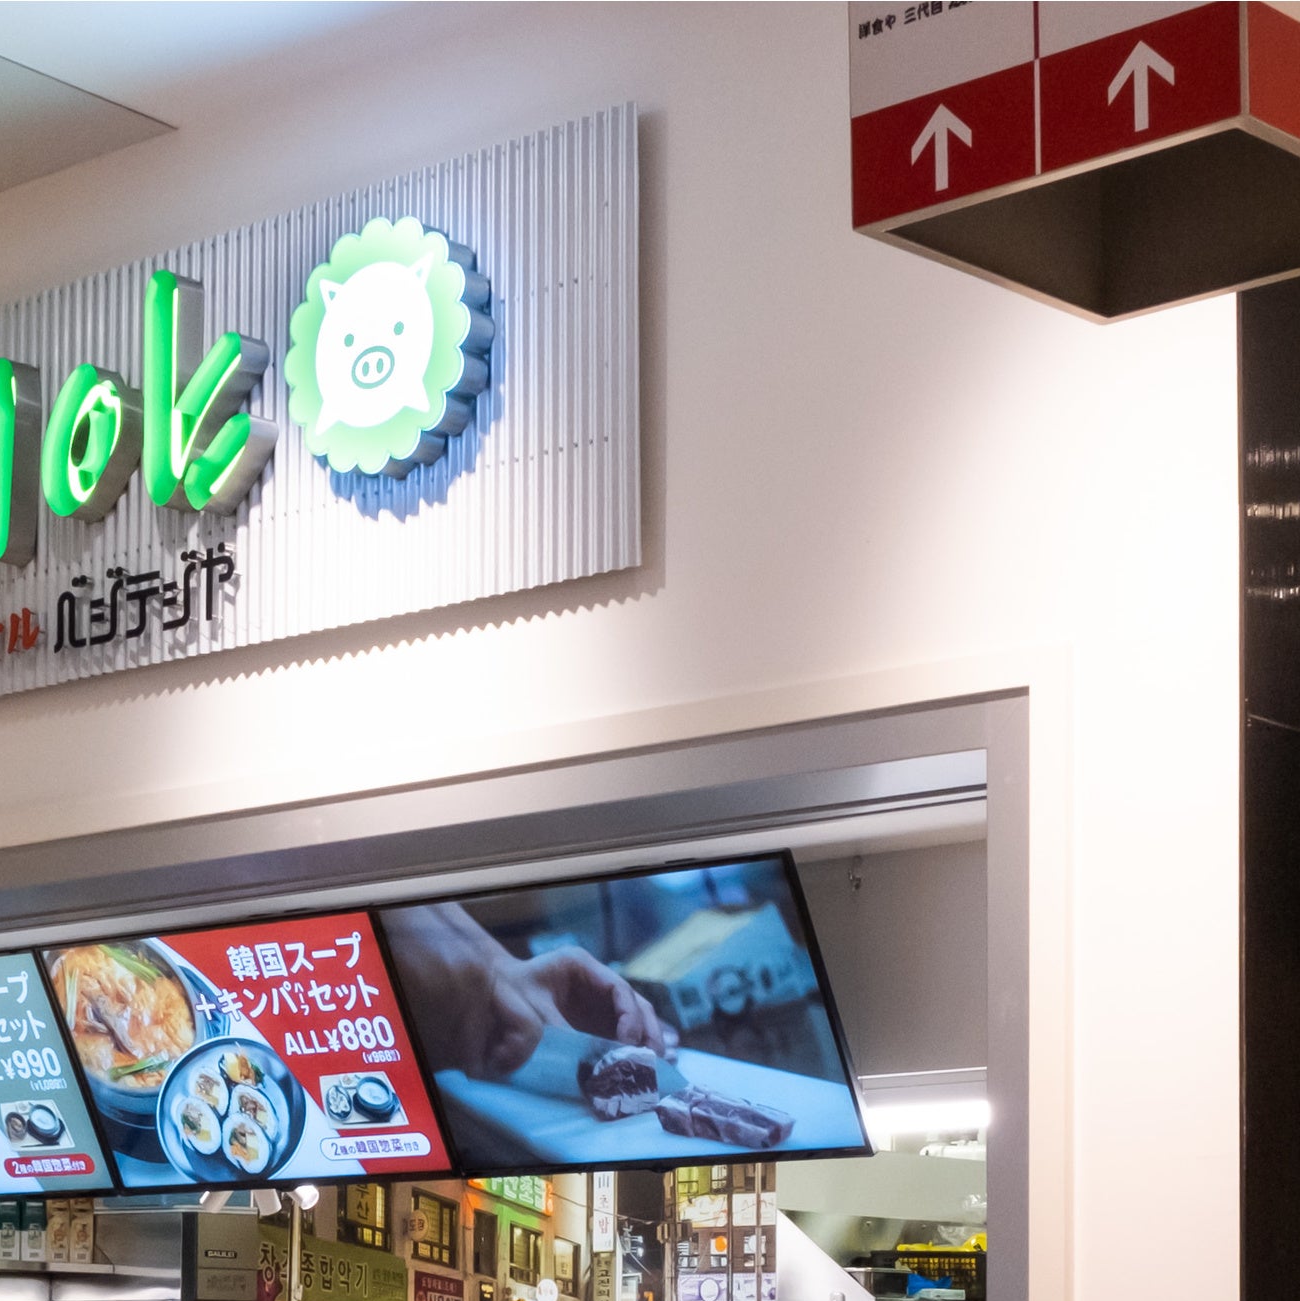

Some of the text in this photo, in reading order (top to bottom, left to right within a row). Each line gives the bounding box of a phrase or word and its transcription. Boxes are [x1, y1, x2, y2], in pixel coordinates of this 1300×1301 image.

[226, 931, 362, 983] 韓国スープ
[284, 1015, 396, 1056] ALL ¥880
[2, 1047, 62, 1081] ¥990
